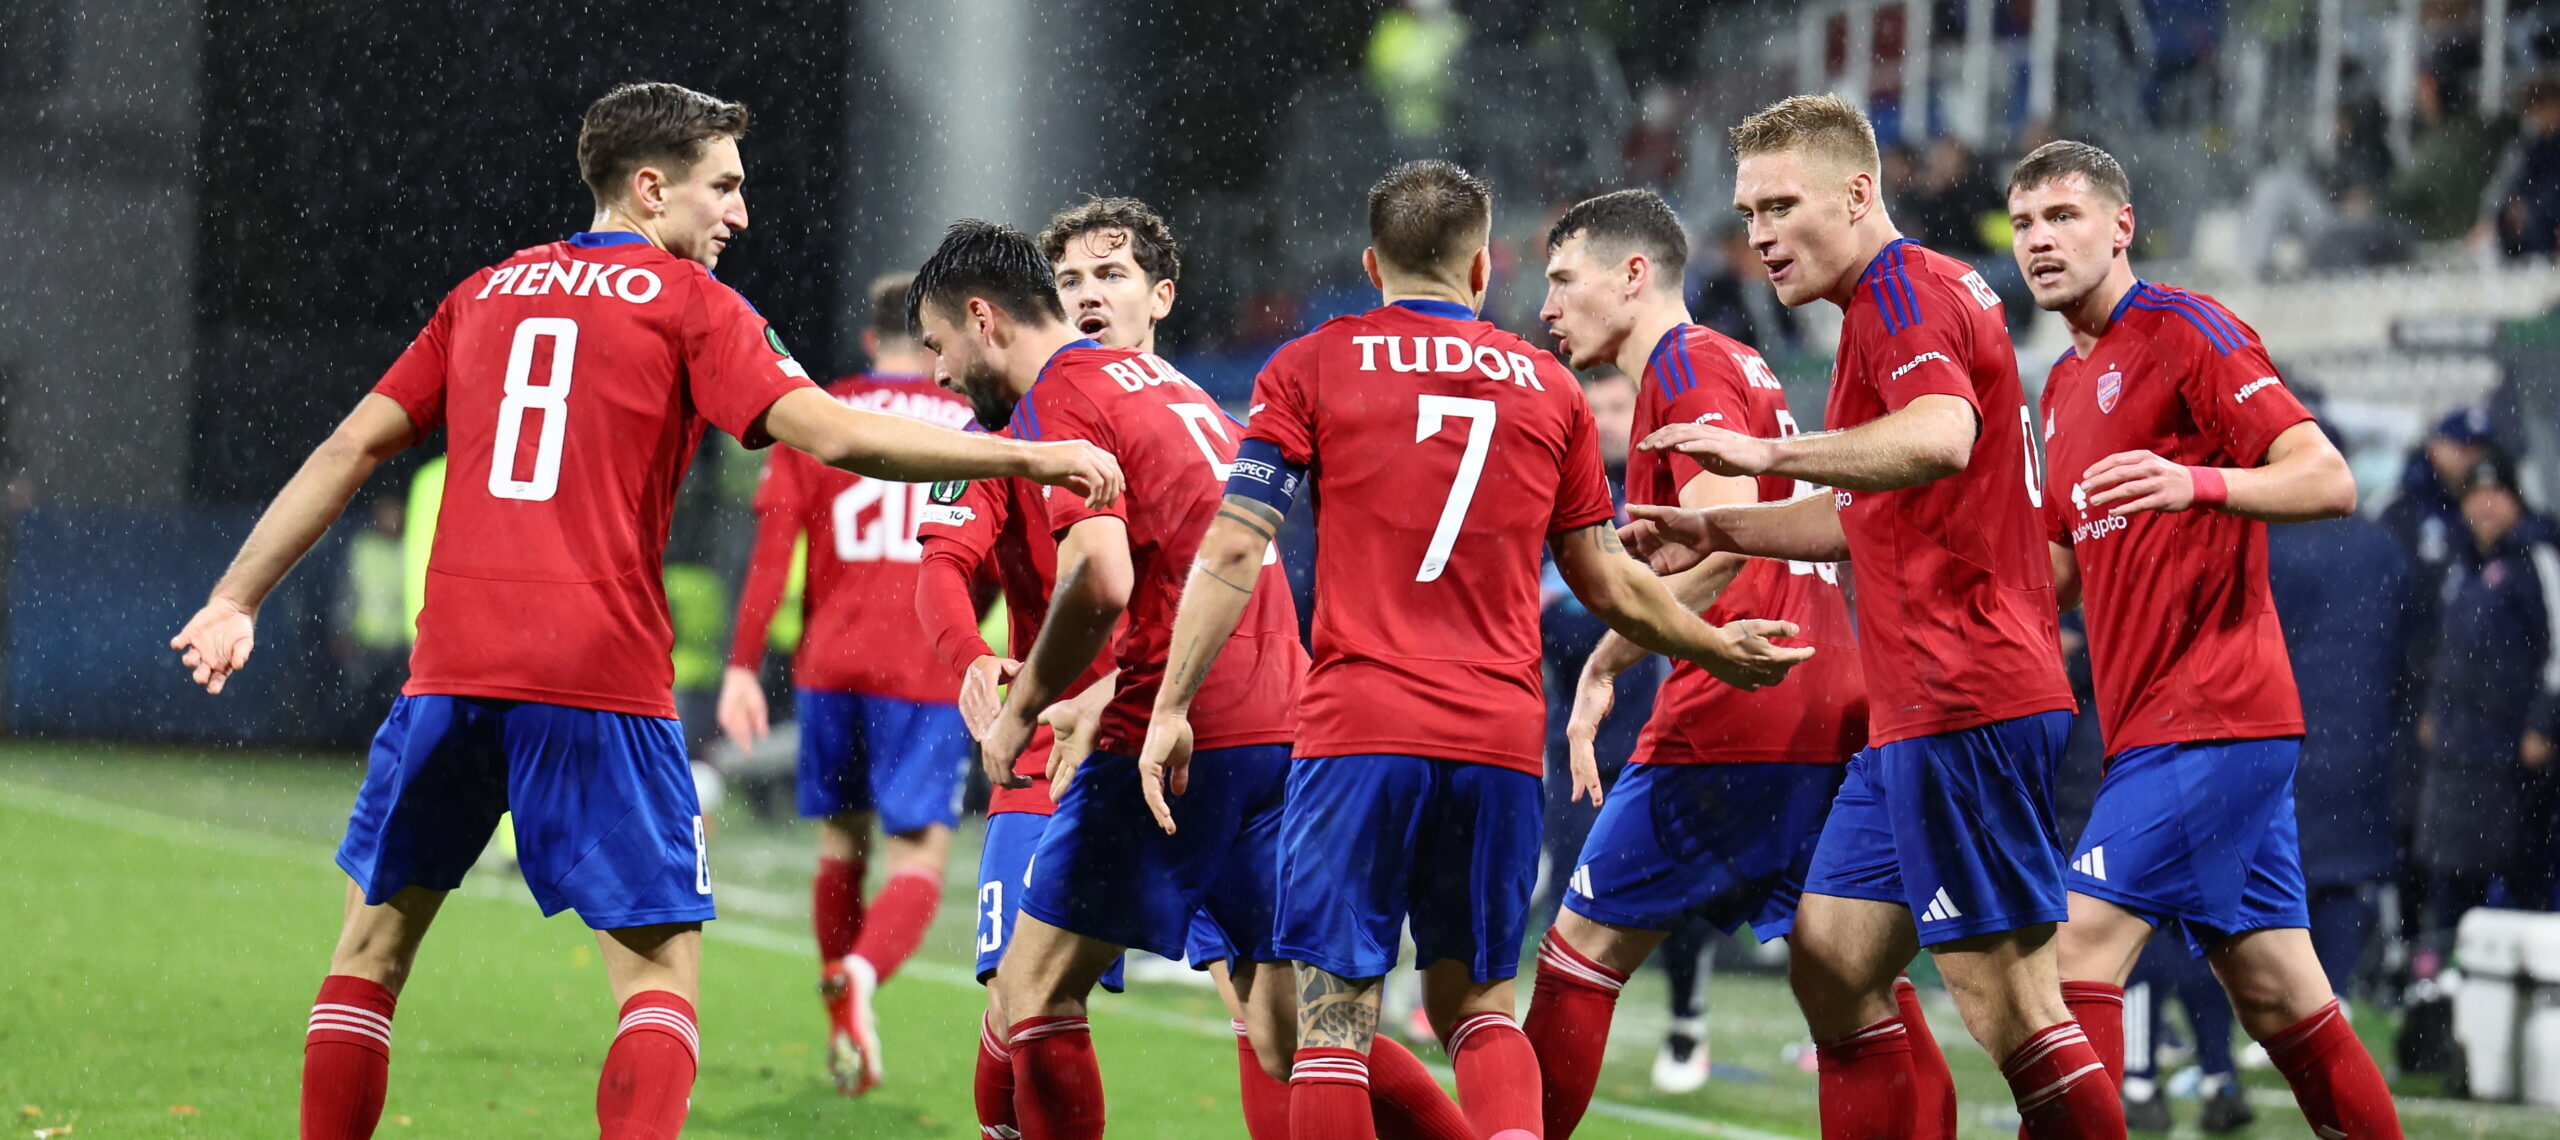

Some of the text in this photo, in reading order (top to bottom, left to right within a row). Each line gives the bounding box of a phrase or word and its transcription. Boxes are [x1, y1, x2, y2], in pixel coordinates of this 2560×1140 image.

[475, 259, 662, 304] PIENKO
[488, 317, 579, 501] 8
[1352, 335, 1546, 391] TUDOR
[1415, 394, 1497, 582] 7
